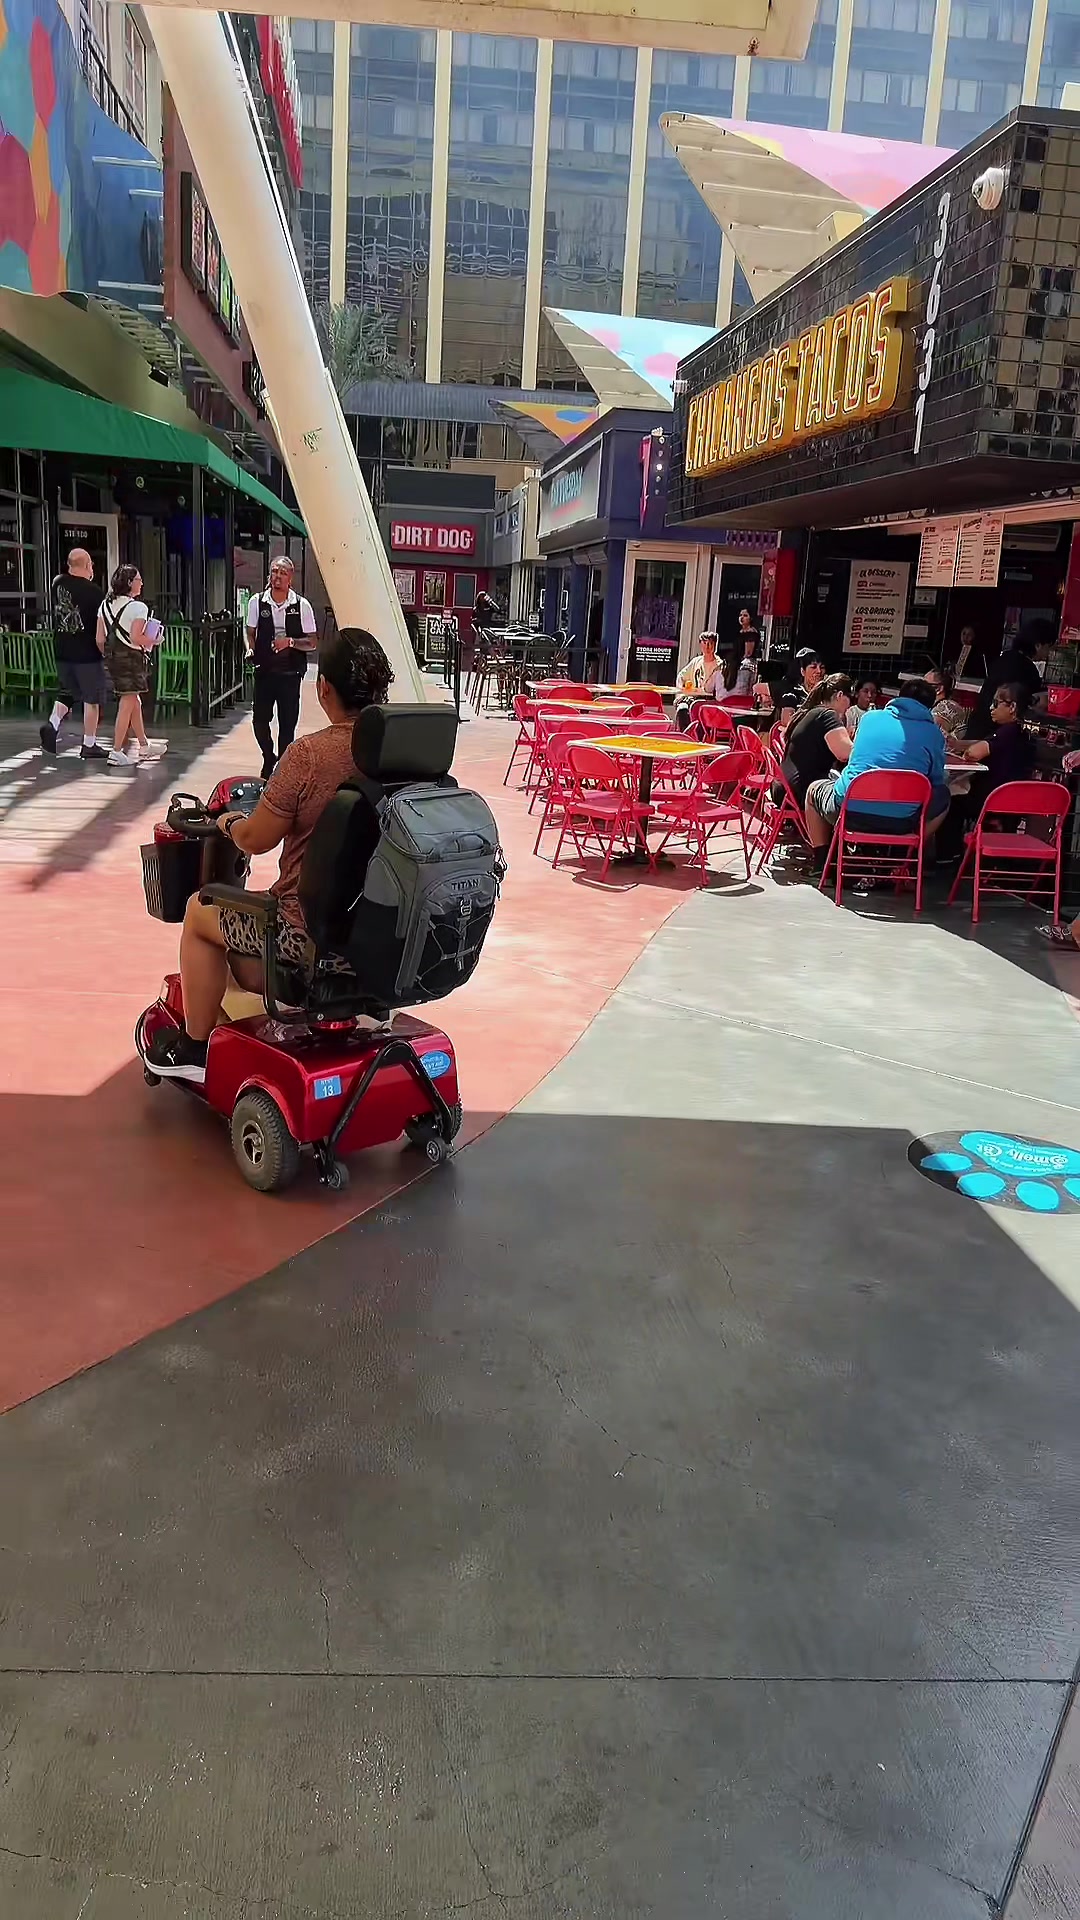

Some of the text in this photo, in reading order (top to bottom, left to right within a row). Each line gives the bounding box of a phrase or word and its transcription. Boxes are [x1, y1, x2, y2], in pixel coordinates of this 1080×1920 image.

[913, 191, 951, 455] 3631
[684, 283, 896, 474] CHILANGOS TACOS
[394, 525, 472, 550] DIRT DOG
[451, 879, 480, 890] TITAN
[322, 1085, 334, 1097] 13
